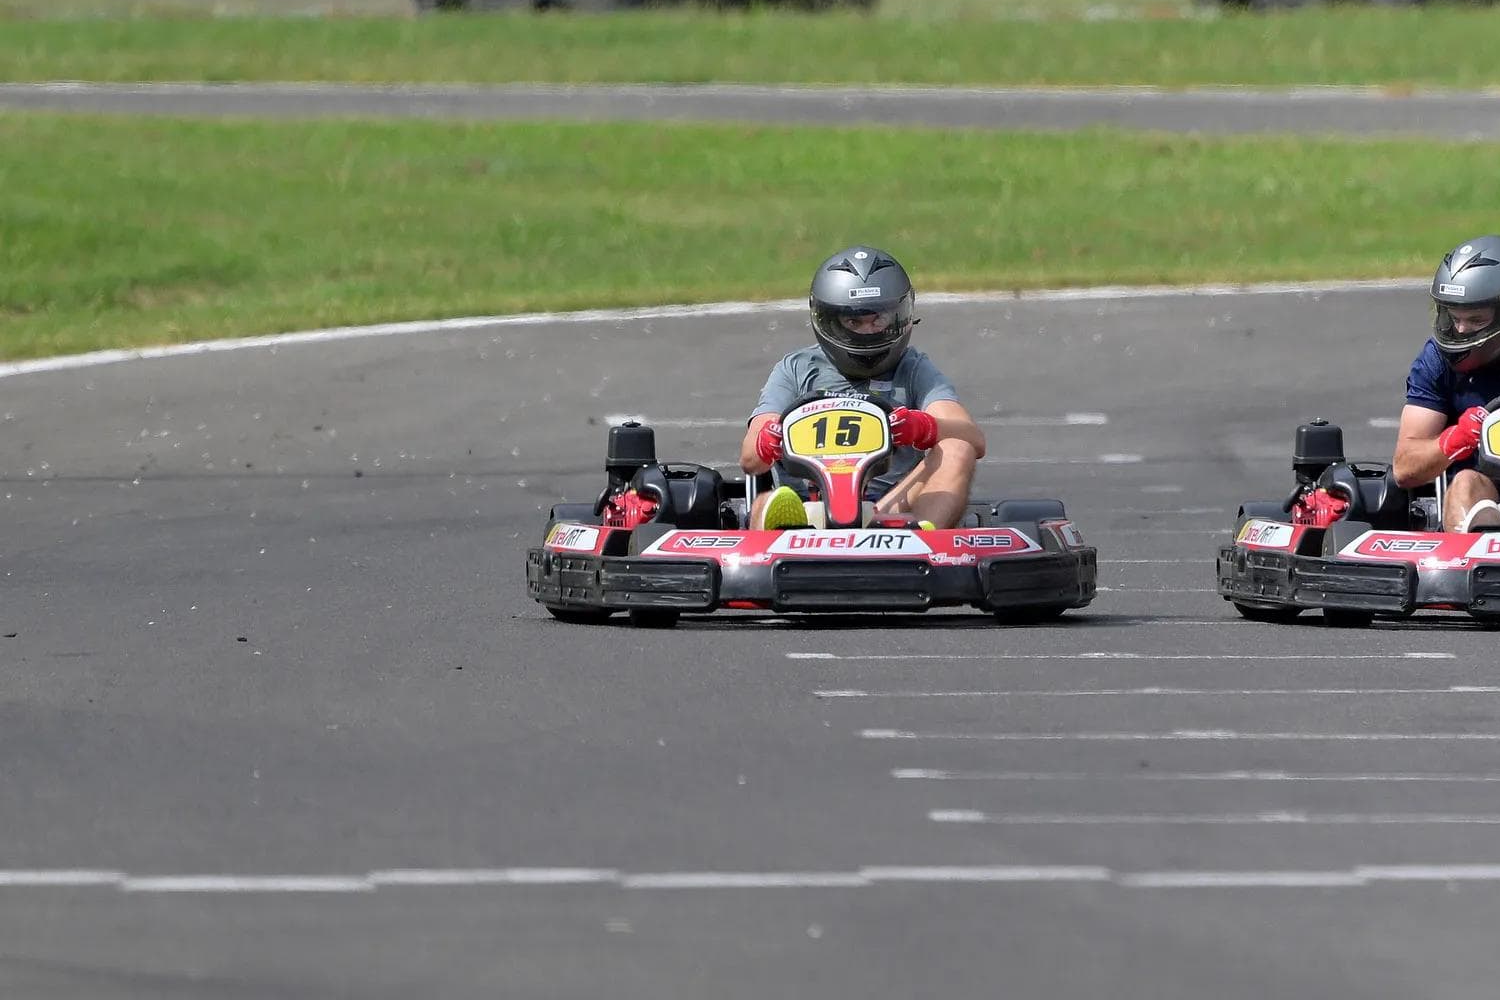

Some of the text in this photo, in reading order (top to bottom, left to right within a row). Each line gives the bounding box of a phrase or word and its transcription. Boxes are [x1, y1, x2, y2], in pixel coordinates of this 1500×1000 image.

[801, 400, 864, 414] birelART
[812, 416, 862, 449] 15
[789, 533, 911, 549] birelART
